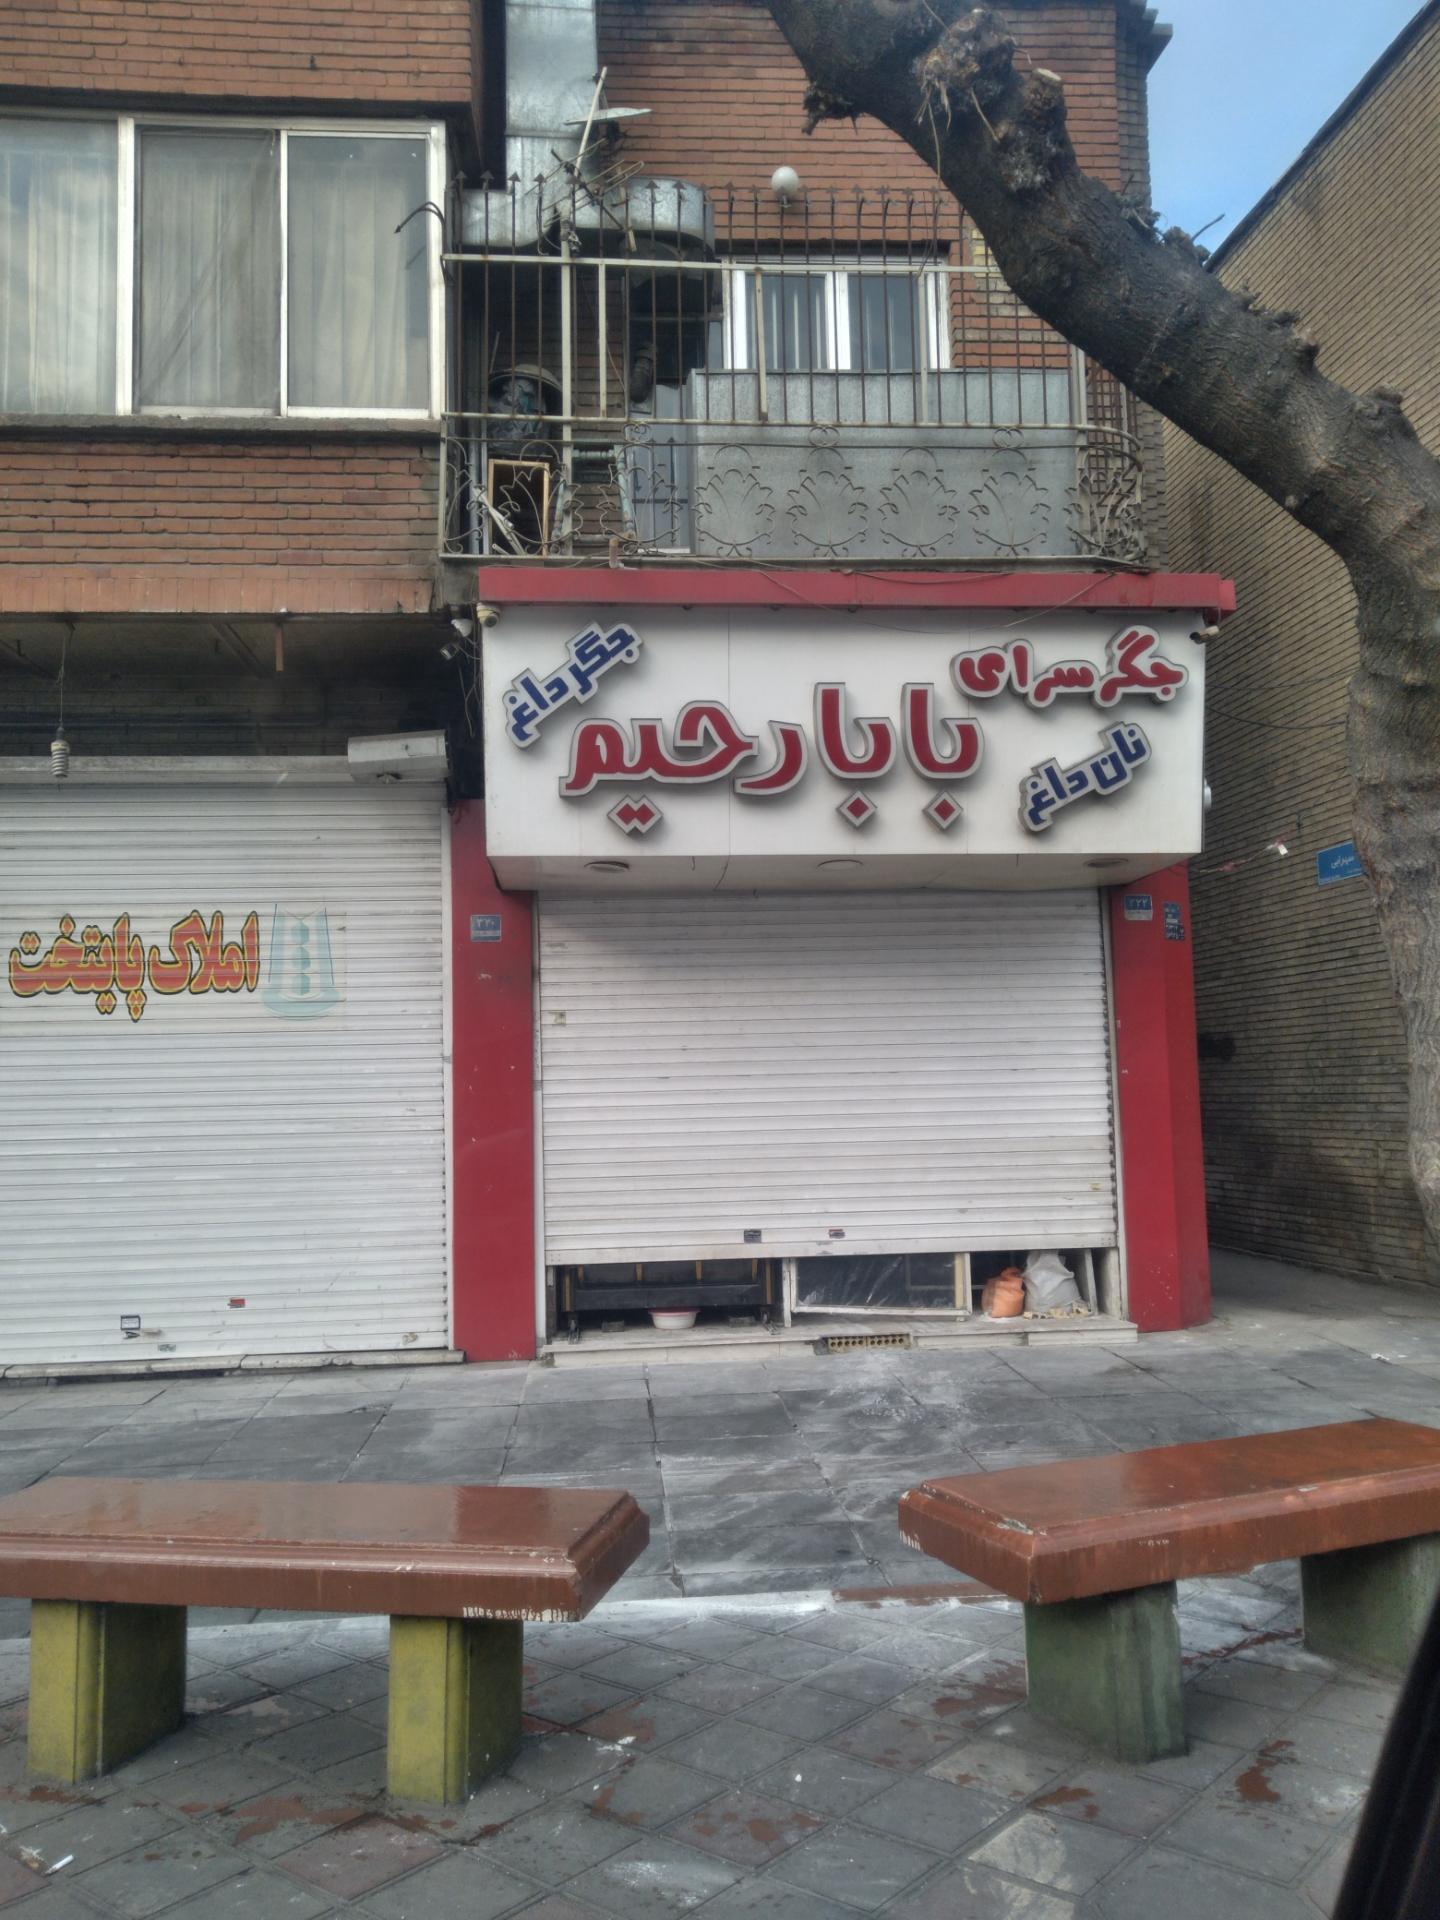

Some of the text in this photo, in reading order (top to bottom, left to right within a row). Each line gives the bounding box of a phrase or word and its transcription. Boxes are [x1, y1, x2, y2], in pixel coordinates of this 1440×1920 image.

[509, 627, 637, 743] جگر داغ
[565, 703, 805, 826] رحیم
[1027, 727, 1148, 827] نان داغ
[8, 910, 261, 1023] املاک پایتخت
